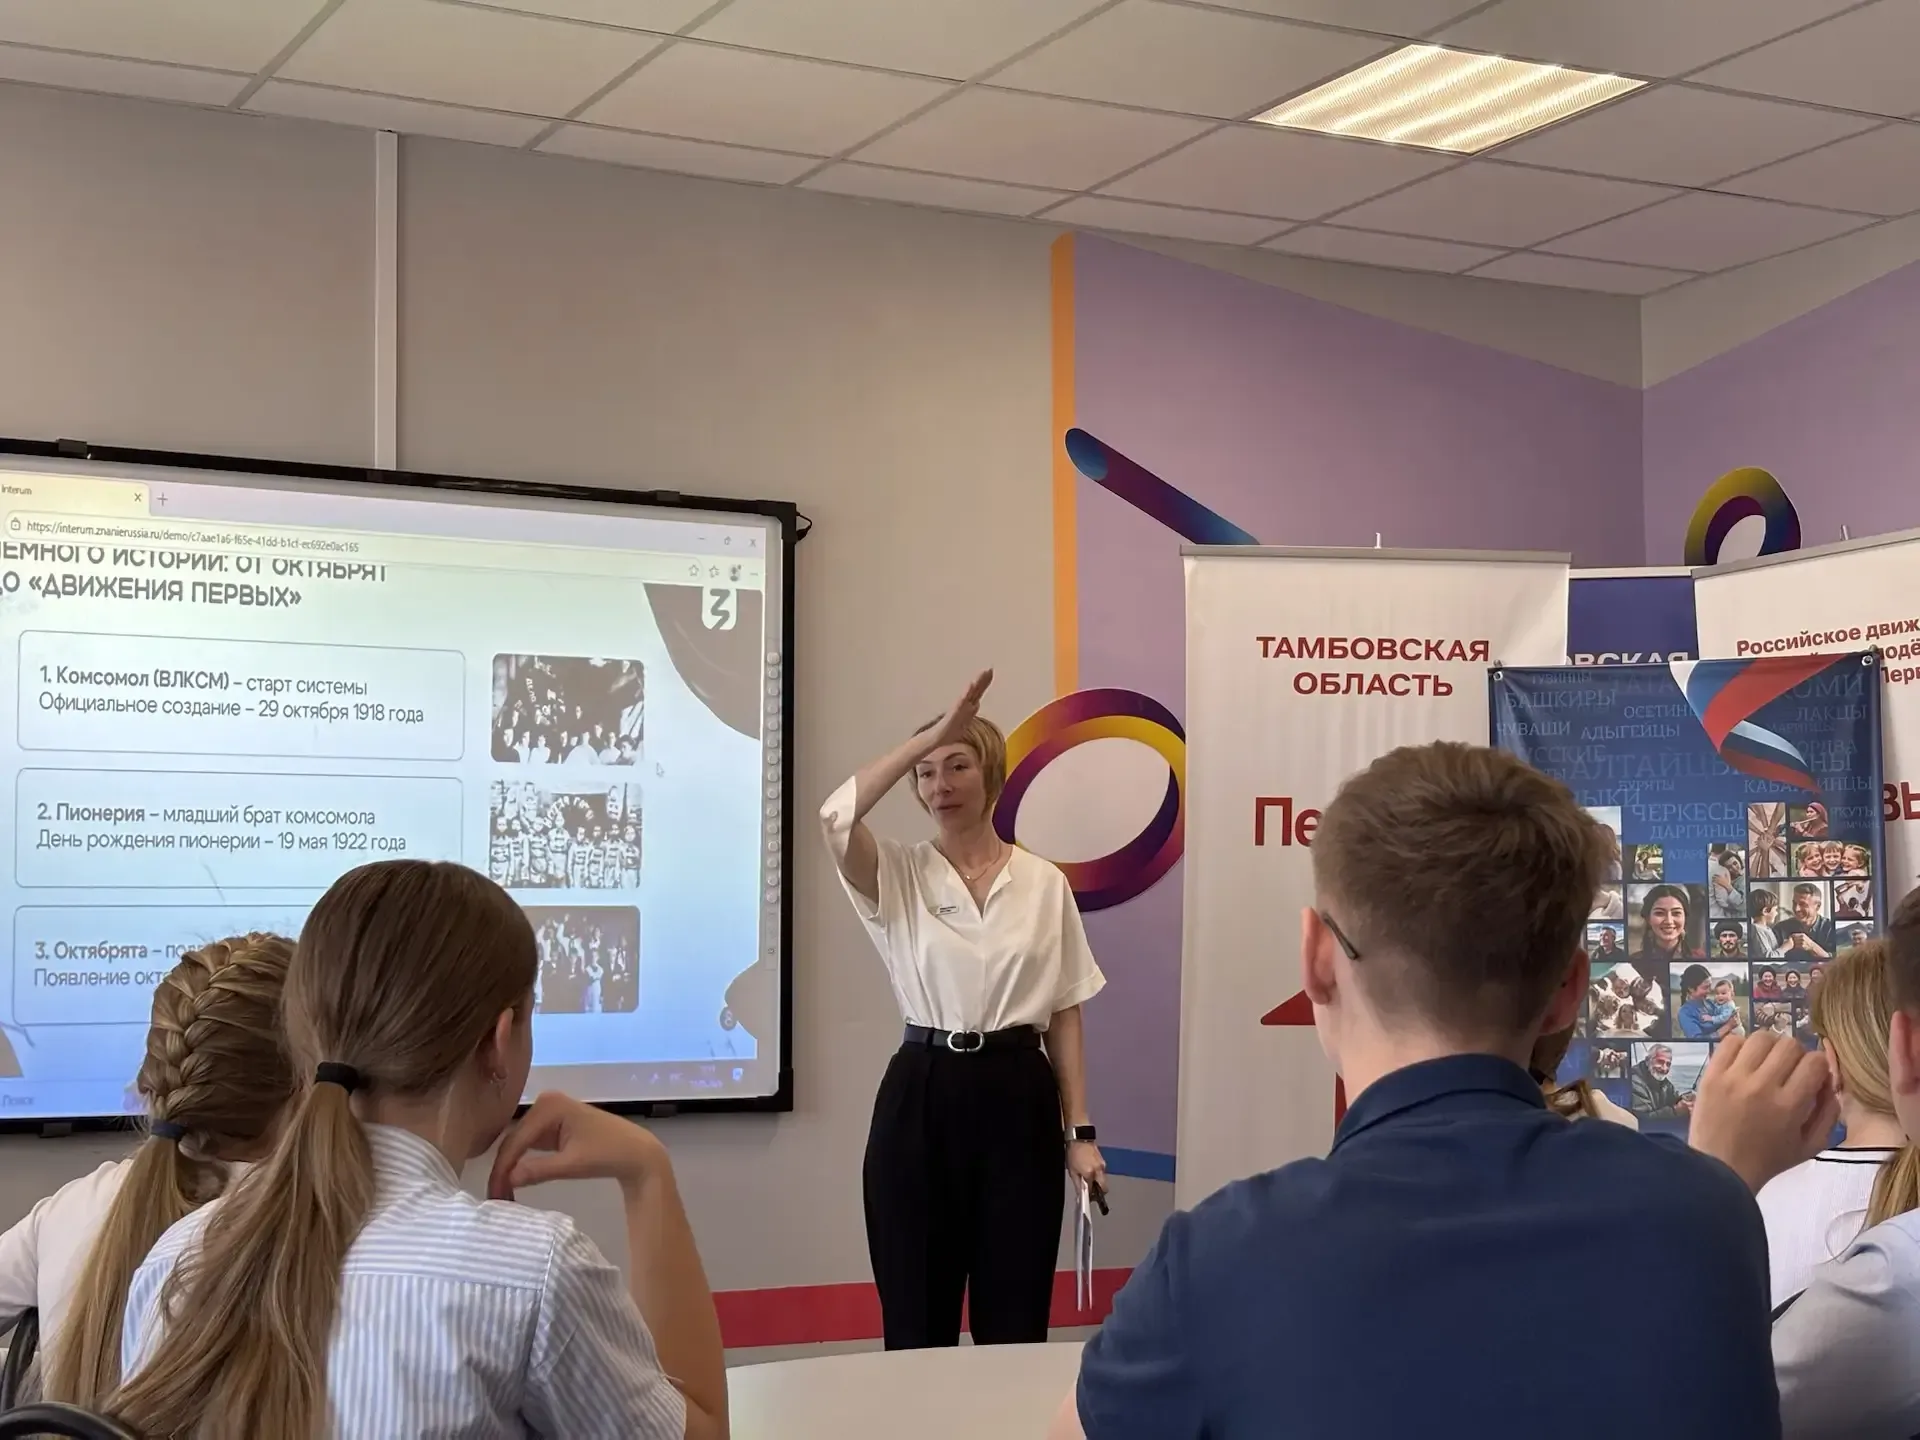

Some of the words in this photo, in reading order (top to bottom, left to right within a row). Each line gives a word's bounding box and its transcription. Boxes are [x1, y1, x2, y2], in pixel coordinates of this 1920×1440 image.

[0, 542, 105, 564] ЕМНОГО
[0, 571, 20, 596] О
[29, 573, 183, 602] «ДВИЖЕНИЯ
[192, 581, 302, 607] ПЕРВЫХ»
[1256, 636, 1490, 662] ТАМБОВСКАЯ
[1737, 627, 1861, 656] Российское
[40, 666, 52, 683] 1.
[56, 666, 149, 688] Комсомол
[153, 668, 229, 690] (ВЛКСМ)
[246, 677, 292, 695] старт
[296, 679, 367, 695] системы
[1293, 672, 1453, 697] ОБЛАСТЬ
[39, 691, 158, 714] Официальное
[162, 698, 241, 717] создание
[259, 700, 279, 718] 29
[283, 701, 349, 723] октября
[353, 704, 384, 721] 1918
[389, 709, 424, 723] года
[1504, 688, 1617, 709] БАШКИРЫ
[1744, 776, 1873, 794] КАБАИНЦЫ
[37, 803, 52, 820] 2.
[56, 803, 145, 825] Пионерия
[163, 804, 239, 825] младший
[243, 805, 282, 828] брат
[286, 809, 376, 826] комсомола
[1255, 797, 1322, 848] Пе
[1632, 802, 1745, 822] ЧЕРКЕСЫ
[36, 830, 82, 850] День
[87, 834, 175, 852] рождения
[179, 834, 260, 852] пионерии
[278, 832, 295, 849] 19
[299, 835, 329, 850] мая
[332, 832, 367, 850] 1922
[371, 835, 406, 852] года
[35, 942, 49, 959] 3.
[54, 941, 148, 963] Октябрята
[35, 968, 130, 987] Появление
